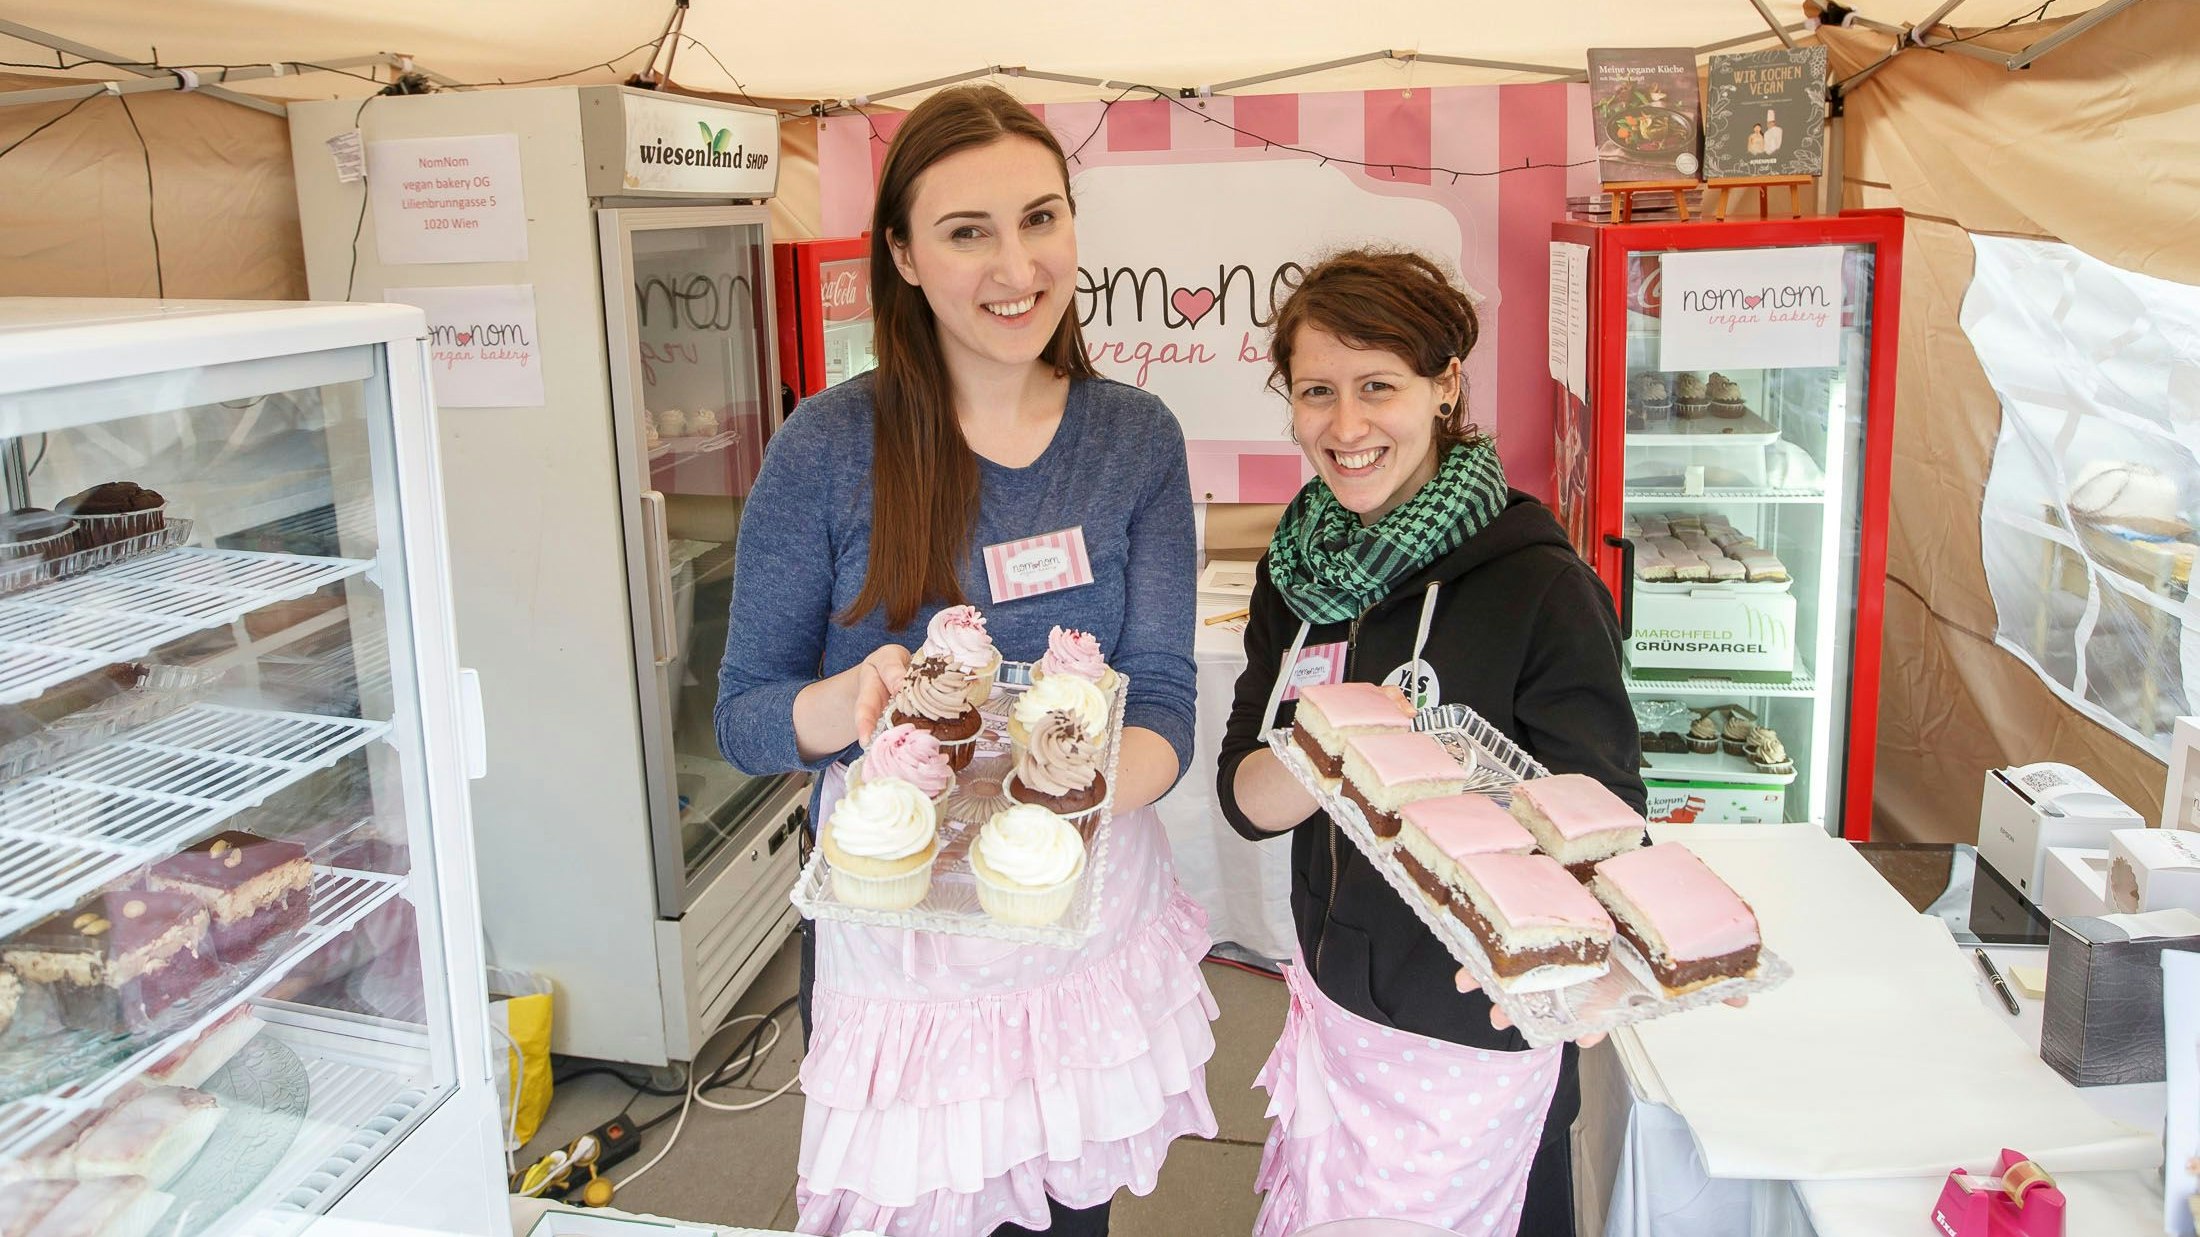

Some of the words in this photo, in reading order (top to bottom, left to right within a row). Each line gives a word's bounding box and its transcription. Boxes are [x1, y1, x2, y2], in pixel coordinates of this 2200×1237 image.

[1599, 65, 1626, 74] Meine
[1627, 66, 1656, 76] vegane
[1657, 65, 1685, 74] Küche
[1733, 69, 1757, 84] WIR
[1760, 65, 1802, 82] KOCHEN
[1749, 81, 1784, 96] VEGAN
[639, 137, 743, 169] wiesenland
[745, 152, 769, 170] SHOP
[418, 156, 469, 169] NomNom
[402, 179, 434, 192] vegan
[436, 177, 471, 191] bakery
[473, 176, 491, 188] OG
[401, 197, 487, 211] Lilienbrunngasse
[489, 195, 497, 207] 5
[423, 218, 449, 231] 1020
[451, 218, 479, 230] Wien
[1708, 311, 1761, 333] vegan
[1768, 309, 1830, 328] bakery
[480, 348, 531, 367] bakery
[1087, 338, 1217, 388] vegan
[1634, 628, 1733, 640] MARCHFELD
[1635, 639, 1768, 654] GRÜNSPARGEL
